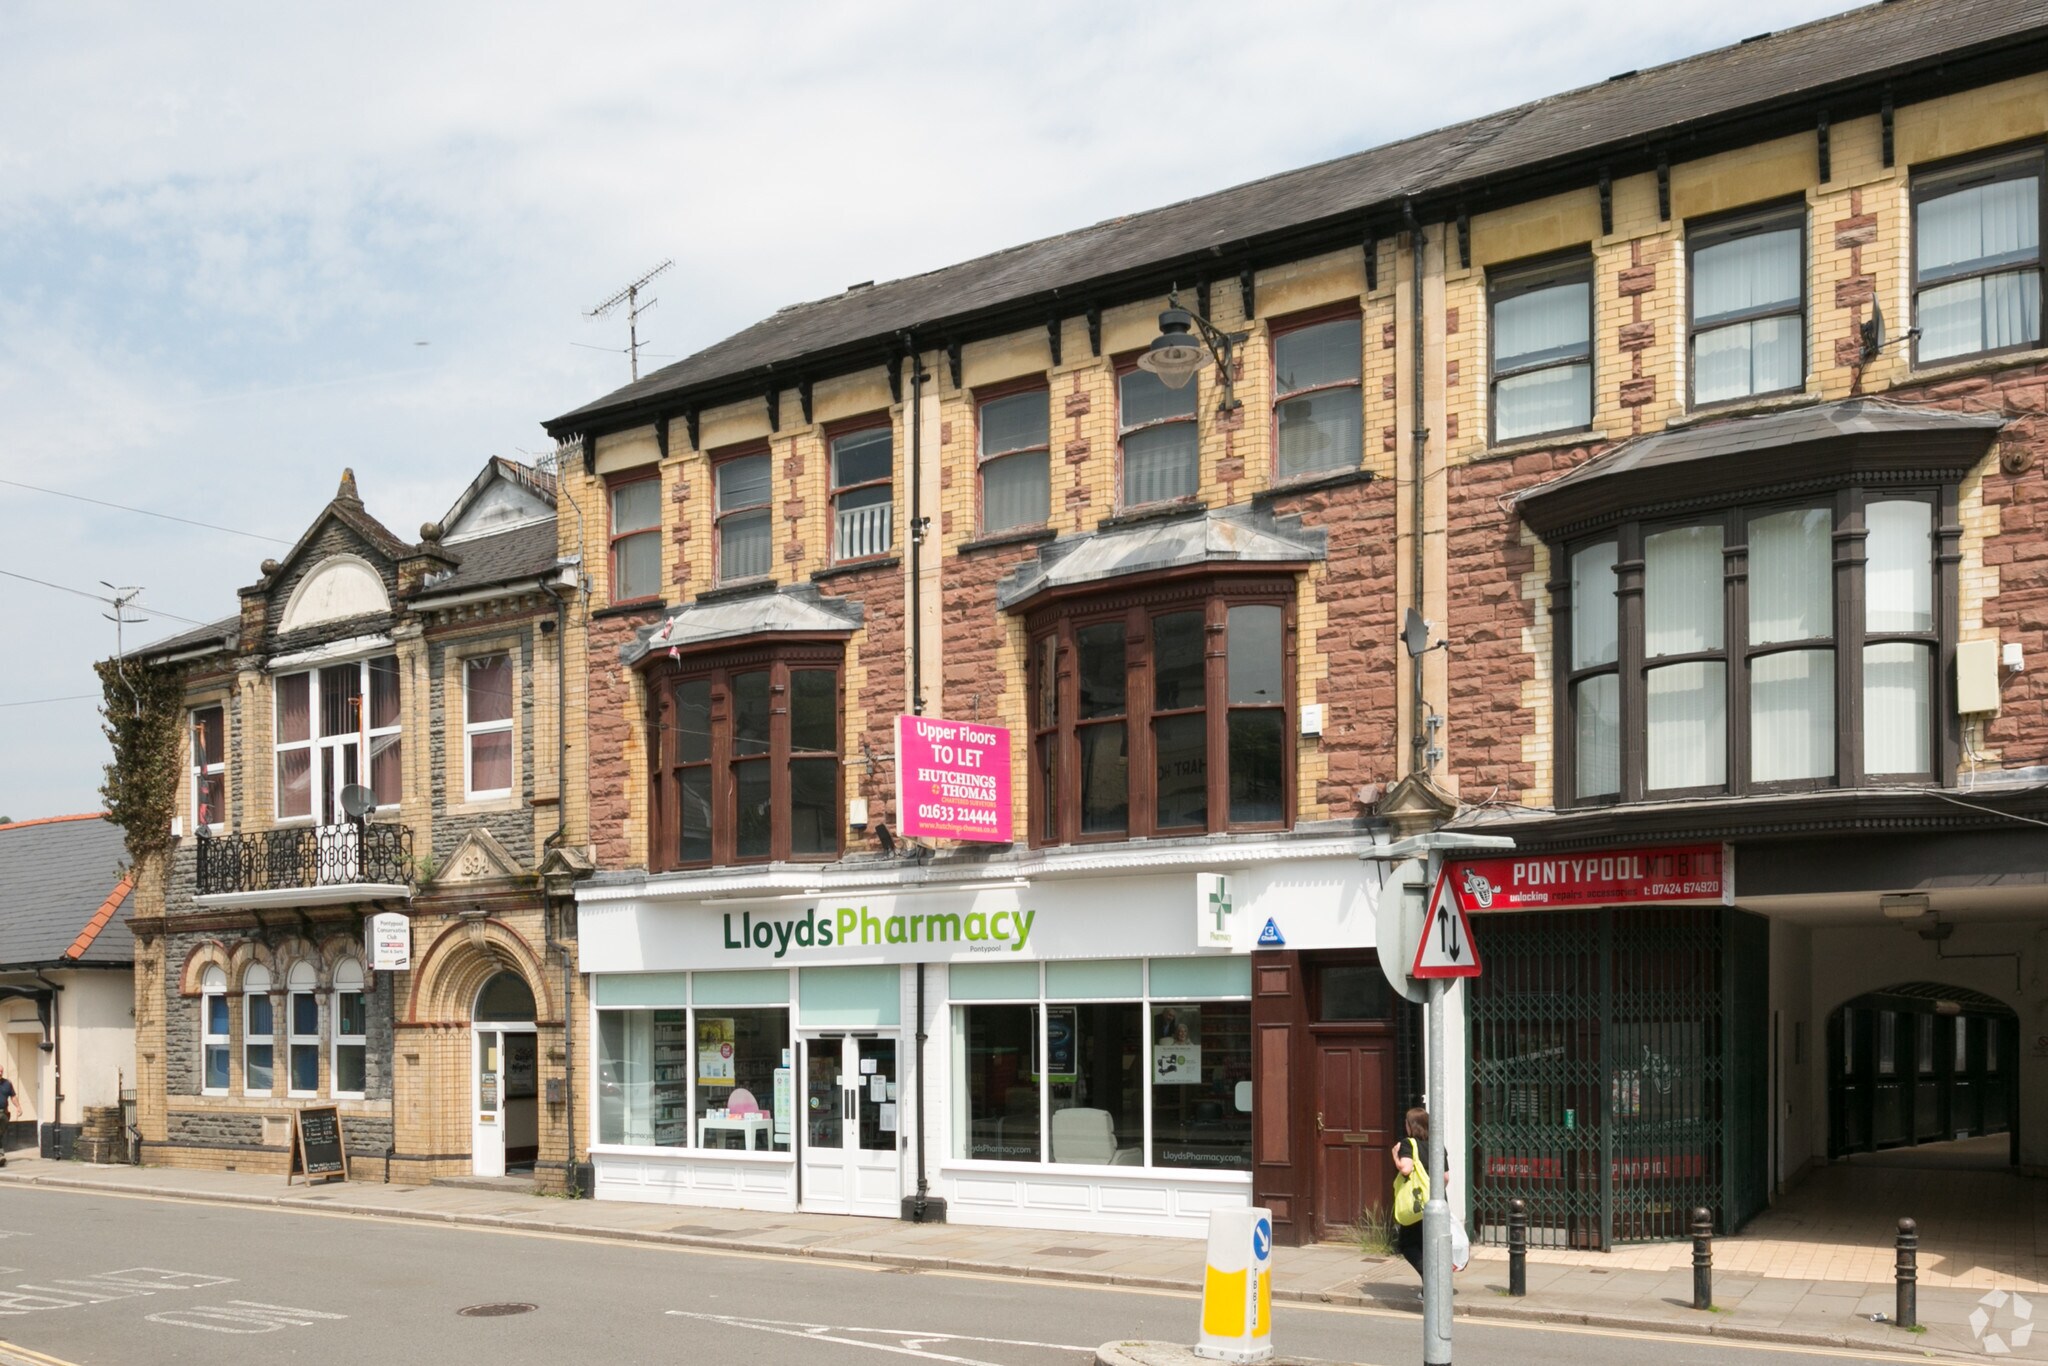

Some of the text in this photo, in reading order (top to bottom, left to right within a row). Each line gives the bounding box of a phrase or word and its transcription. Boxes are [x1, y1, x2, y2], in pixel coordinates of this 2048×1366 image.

[916, 721, 997, 746] Upper Floors
[931, 744, 983, 768] TO LET
[918, 768, 997, 788] HUTCHINGS
[941, 784, 997, 801] THOMAS
[918, 804, 997, 826] 01633 214444
[1513, 856, 1644, 886] PONTYPOOL
[1509, 892, 1549, 903] unlocking
[1551, 890, 1583, 902] repairs
[1586, 887, 1638, 899] accessories
[1652, 883, 1682, 896] 07424
[1683, 881, 1720, 894] 674920
[723, 906, 1036, 958] LloydsPharmacy
[969, 944, 1002, 954] Pontypool
[1163, 1151, 1242, 1163] LloydsPharmacy.com
